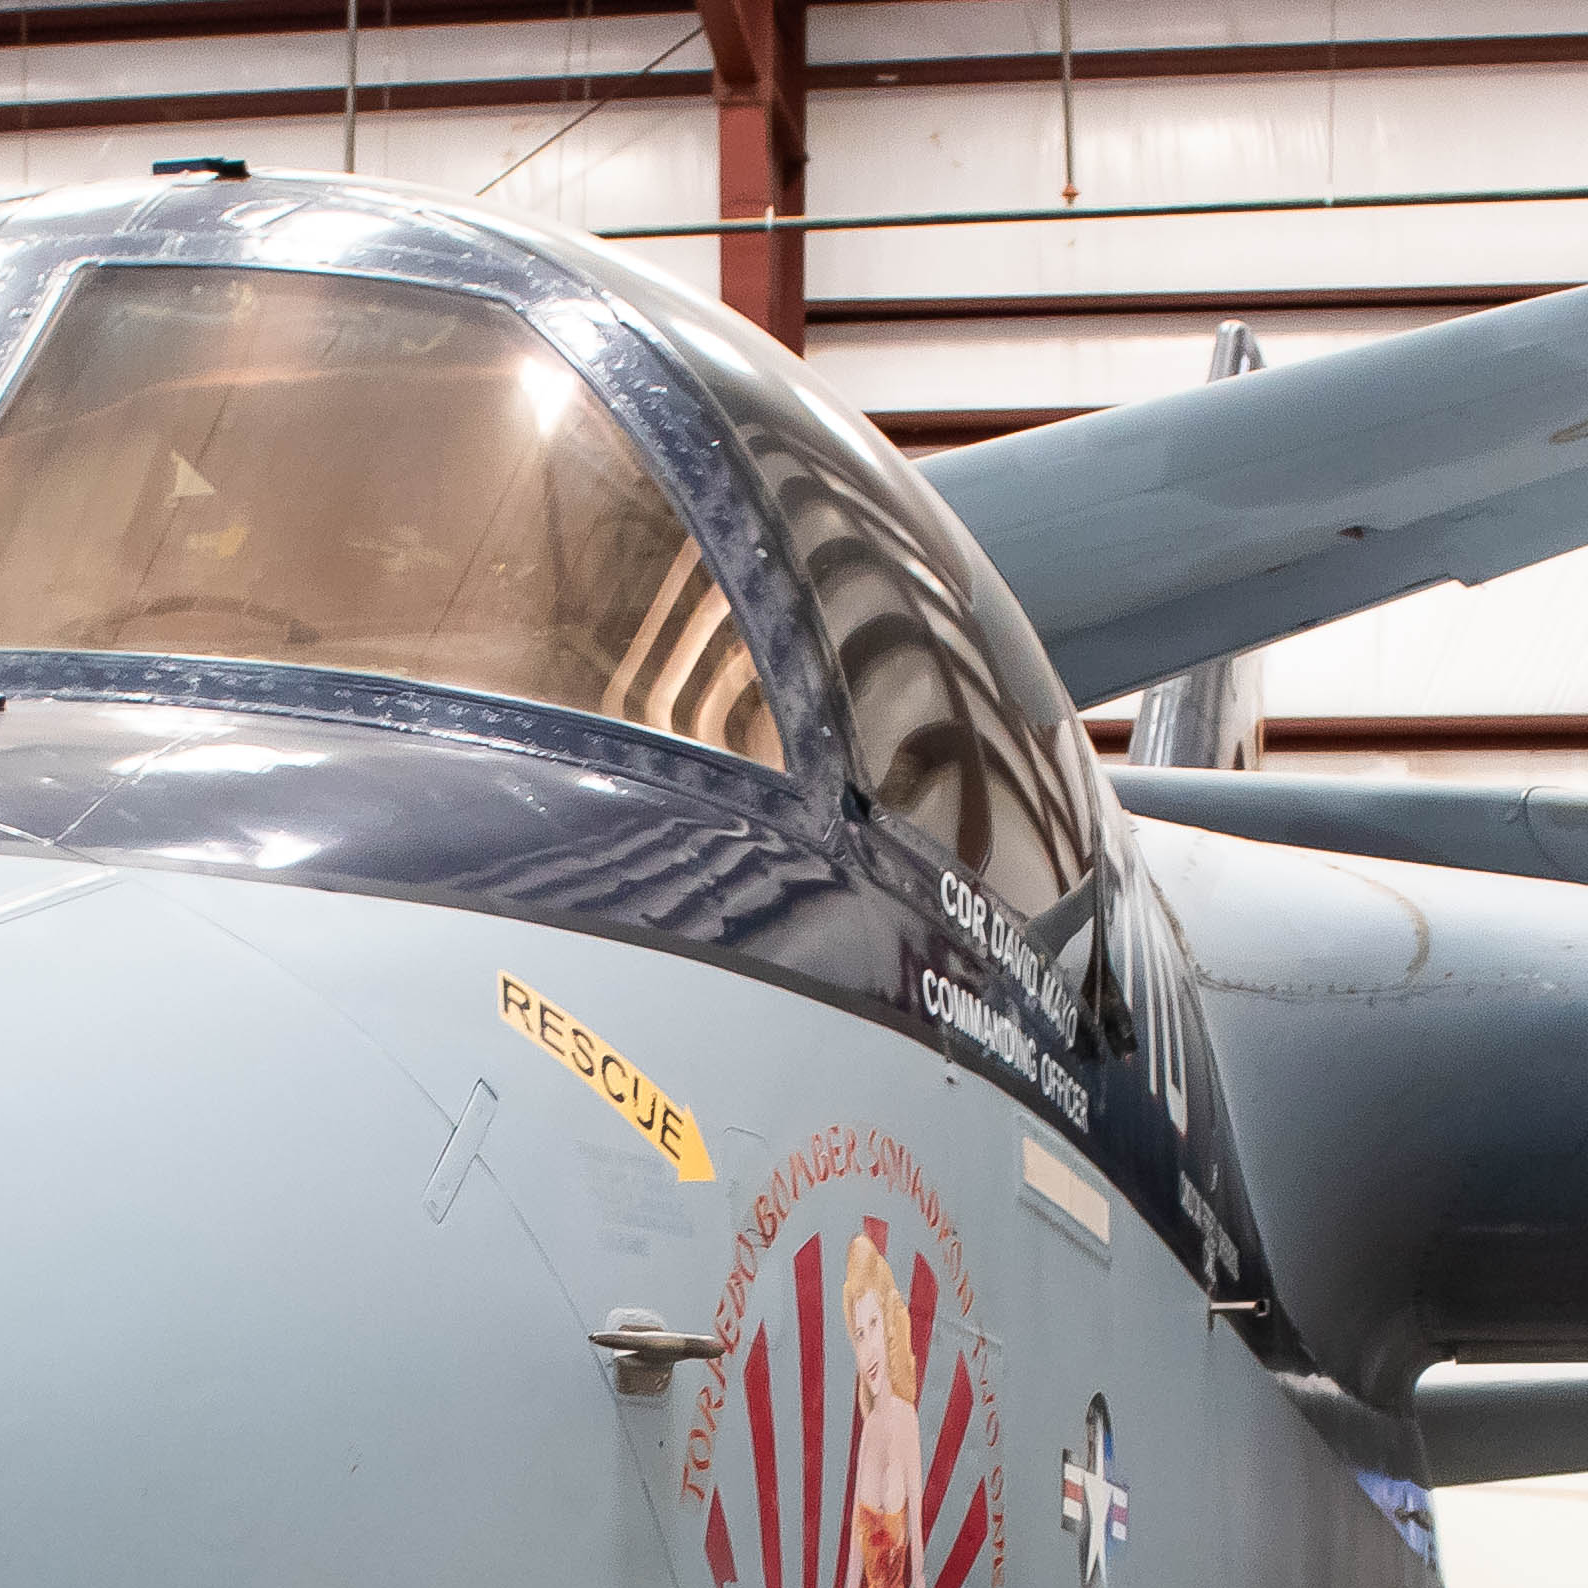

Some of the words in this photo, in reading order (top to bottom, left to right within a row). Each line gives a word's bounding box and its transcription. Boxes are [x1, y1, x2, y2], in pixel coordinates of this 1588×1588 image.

[940, 871, 988, 945] CDR
[990, 911, 1039, 996] DAVID
[500, 976, 685, 1160] RESCUE
[922, 968, 1038, 1083] COMMANDING
[1040, 1052, 1089, 1134] OFFICER
[753, 1124, 861, 1250] BOMBER
